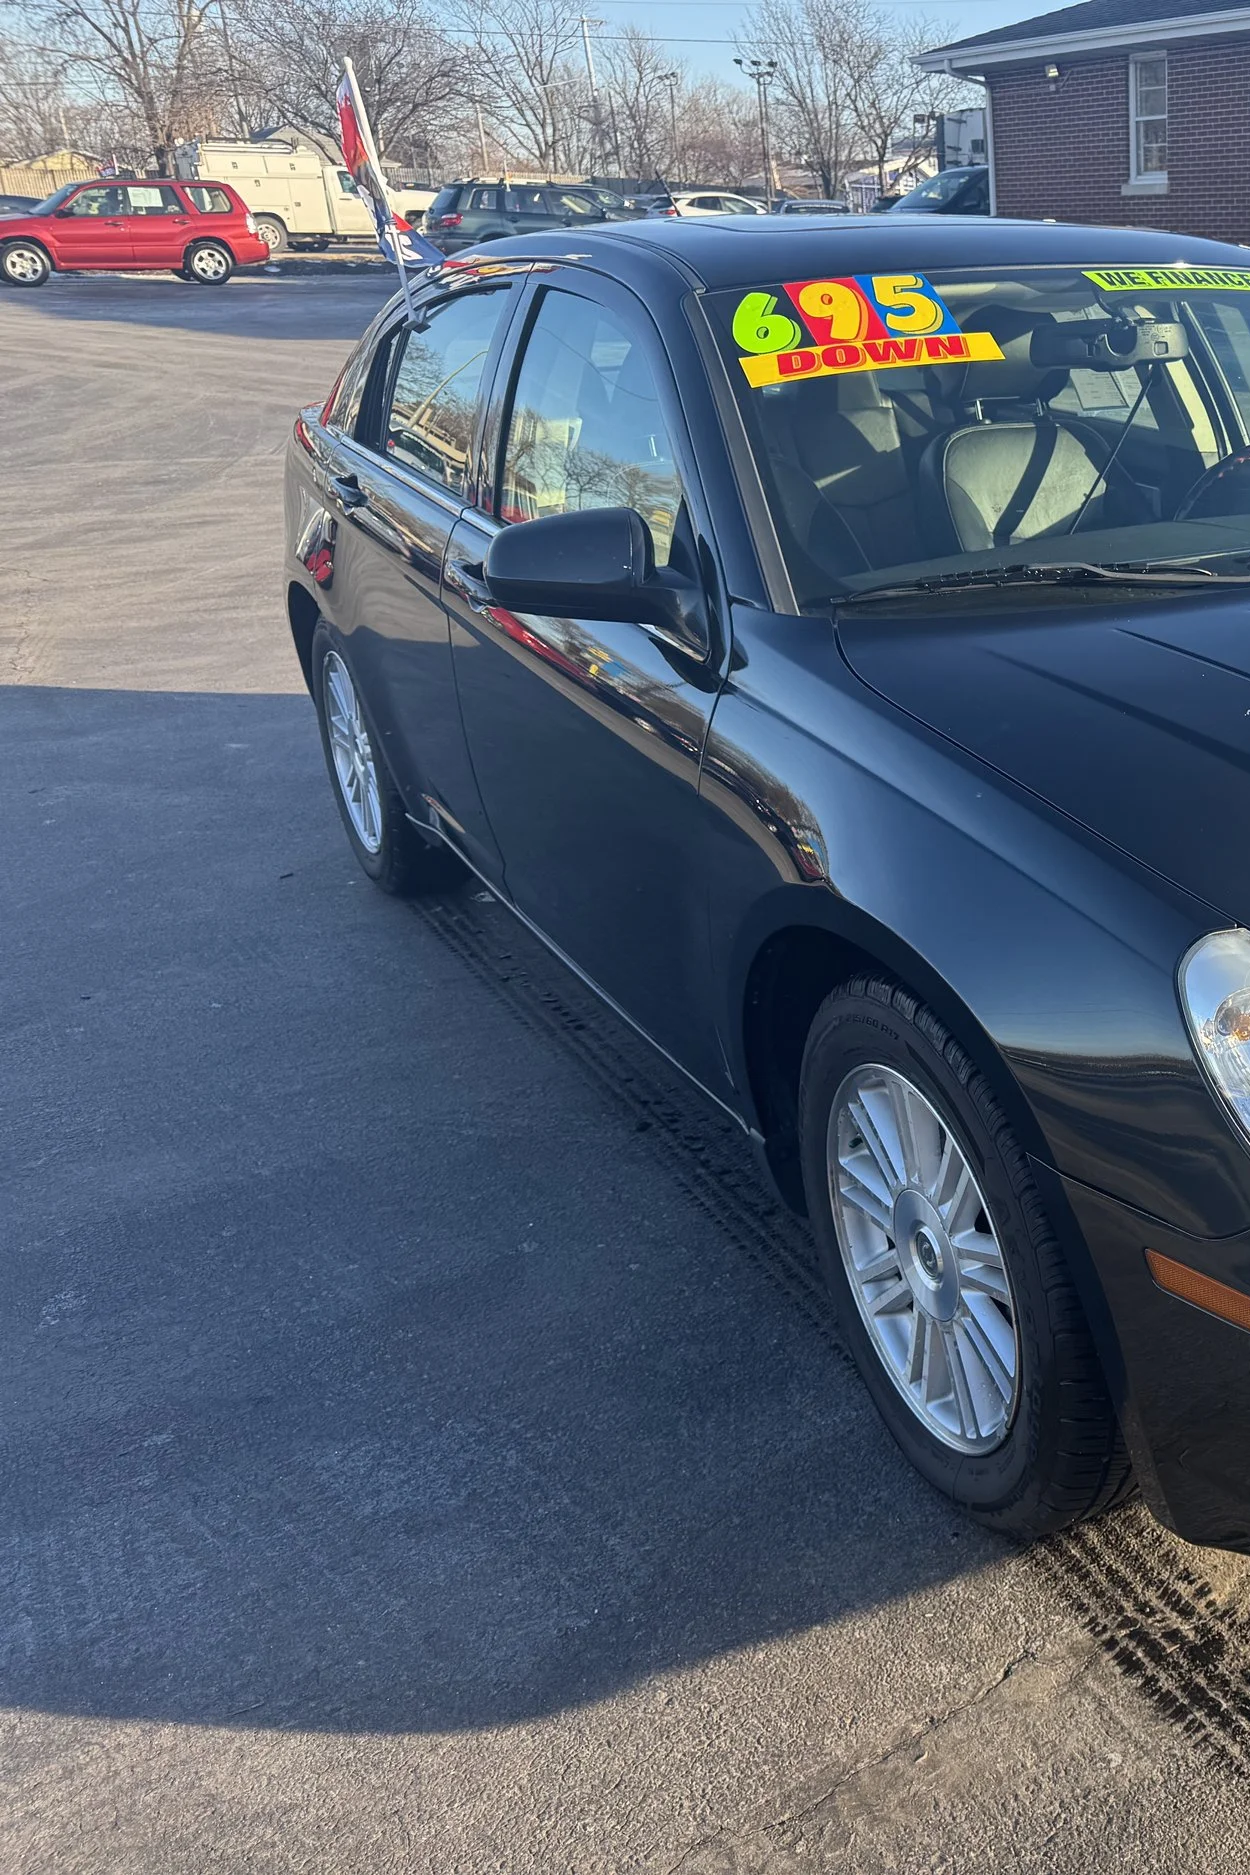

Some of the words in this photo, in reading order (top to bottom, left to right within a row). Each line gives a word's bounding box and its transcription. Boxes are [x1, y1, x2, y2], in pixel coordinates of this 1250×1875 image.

[1097, 271, 1146, 287] WE
[732, 275, 943, 354] 695
[777, 336, 971, 376] DOWN
